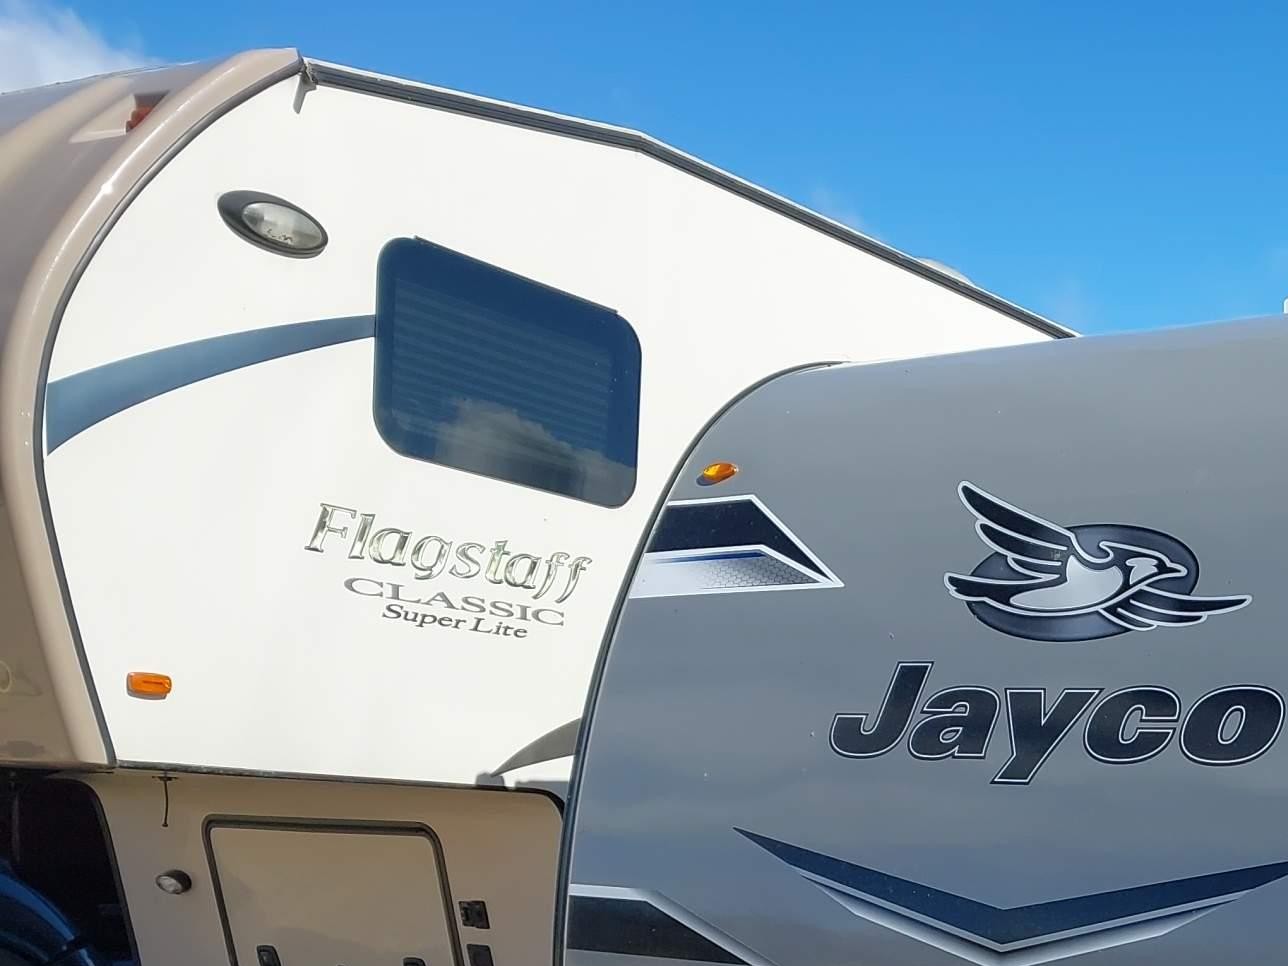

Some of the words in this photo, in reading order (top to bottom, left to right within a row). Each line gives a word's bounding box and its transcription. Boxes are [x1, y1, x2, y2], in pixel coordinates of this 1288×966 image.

[304, 502, 593, 603] Flagstaff
[343, 577, 565, 617] CLASSIC
[382, 603, 467, 628] Super
[469, 616, 528, 638] Lite
[828, 661, 1286, 784] Jayco
